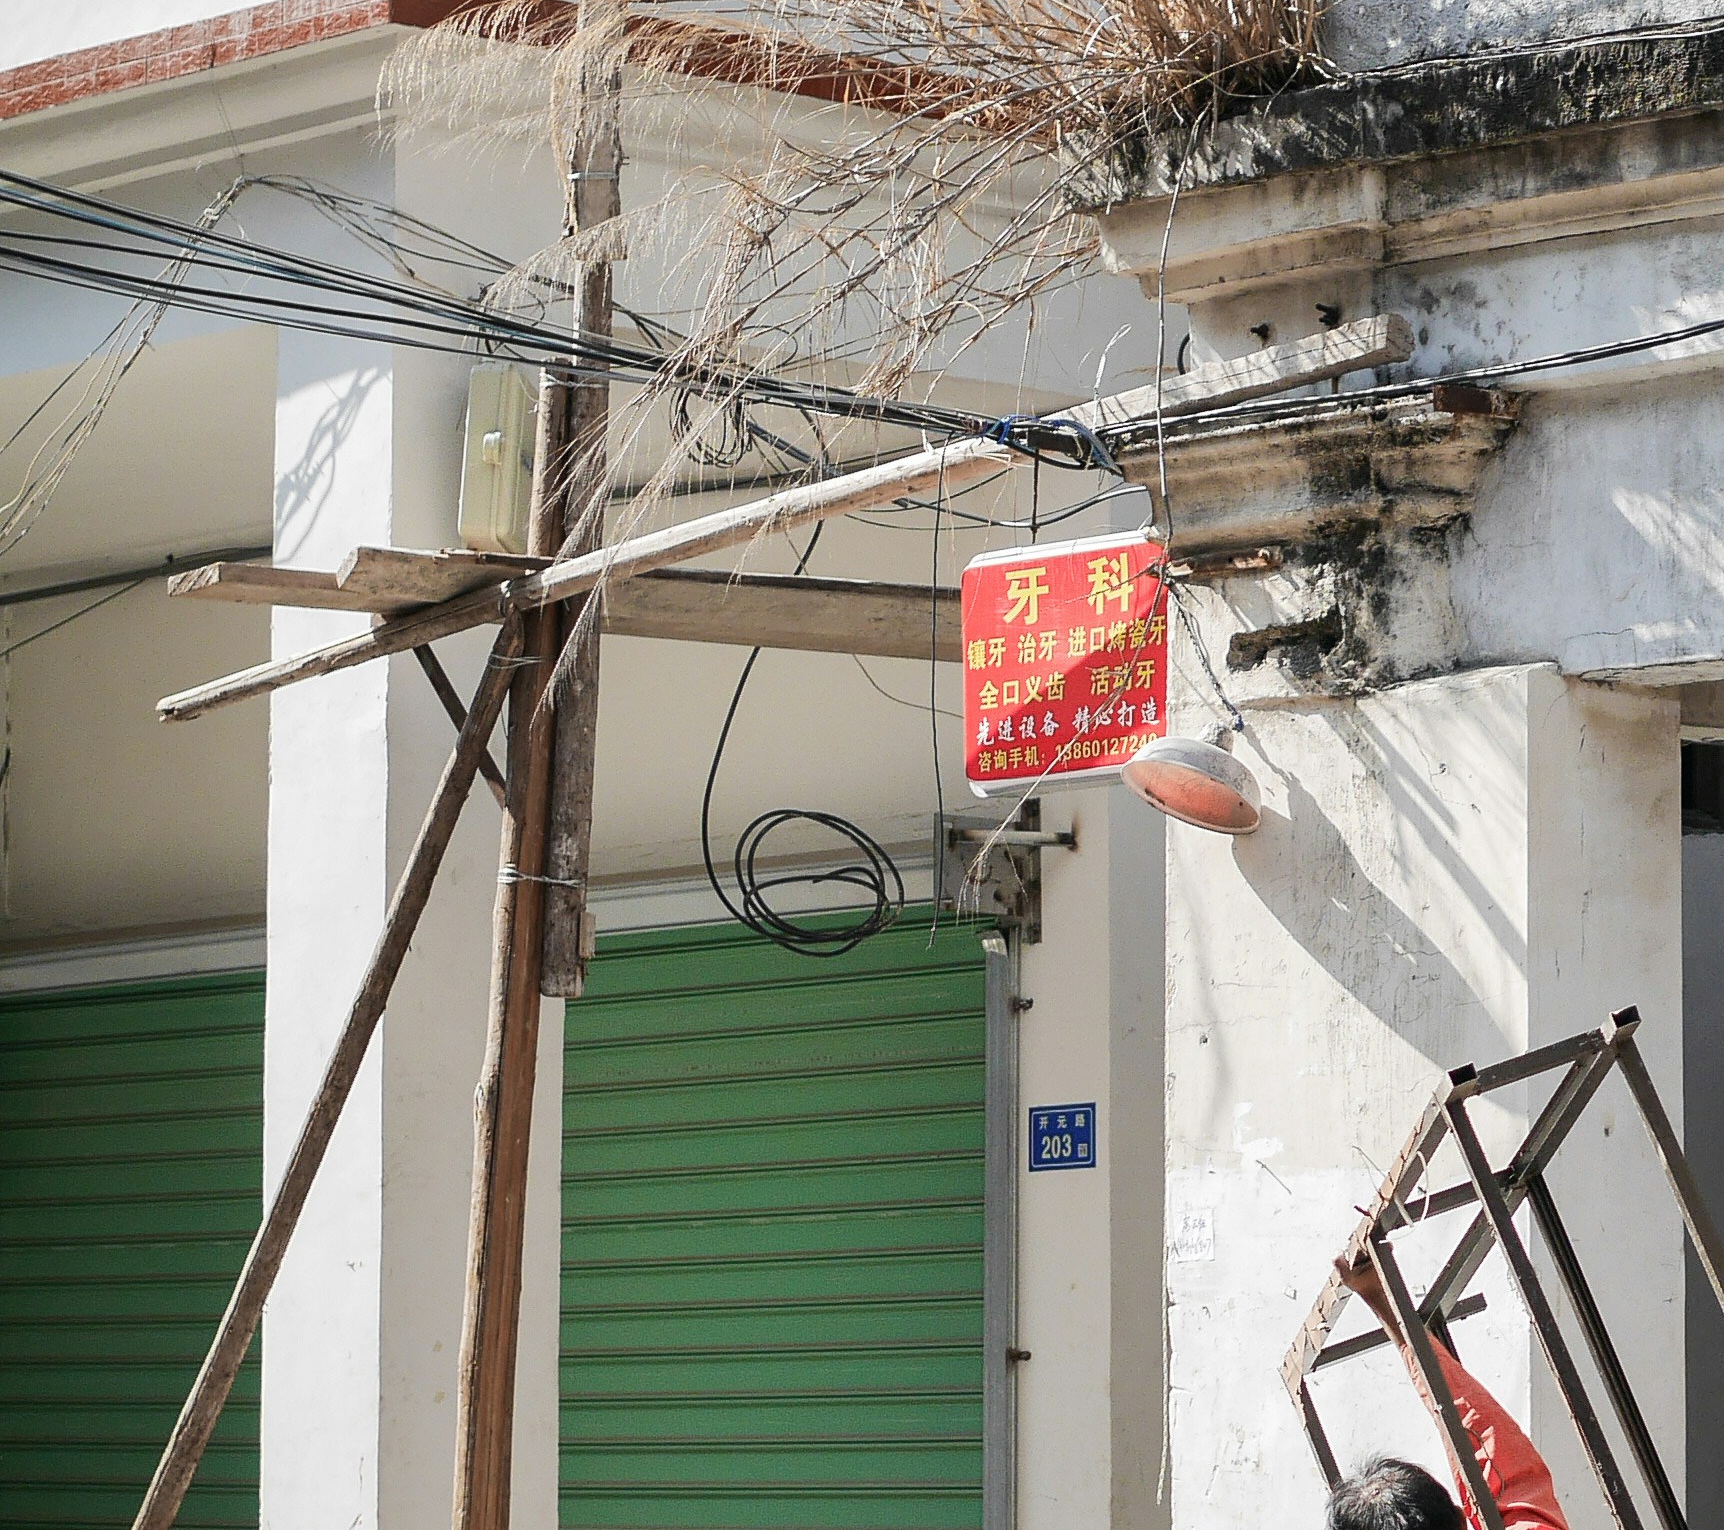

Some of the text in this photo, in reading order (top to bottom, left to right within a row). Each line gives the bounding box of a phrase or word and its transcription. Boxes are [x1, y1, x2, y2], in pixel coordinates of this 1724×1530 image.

[1003, 552, 1134, 625] 牙科
[967, 615, 1167, 671] 镶牙 治牙 进口烤瓷牙
[978, 659, 1156, 710] 全口义齿 活动牙
[975, 698, 1161, 747] 先进设备 精心打造
[1038, 1113, 1085, 1130] 开元路
[1041, 1133, 1072, 1159] 203
